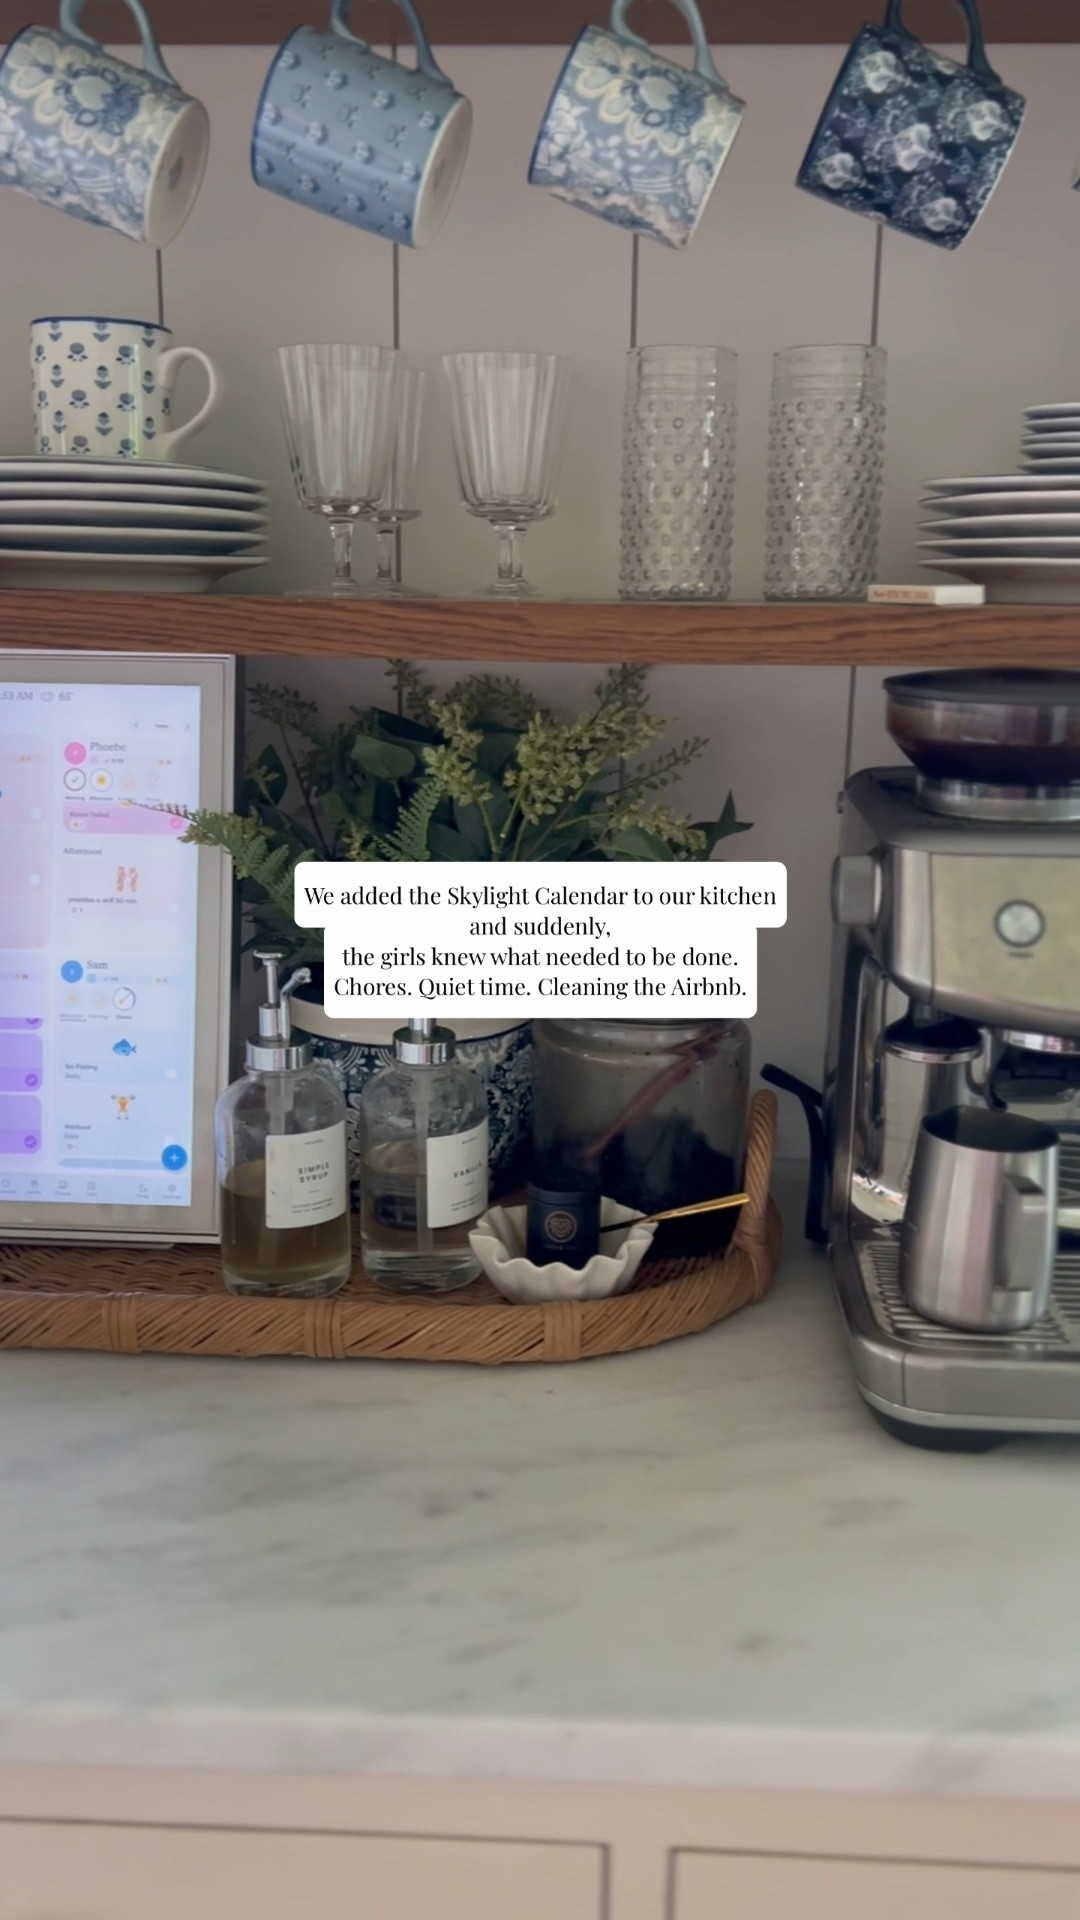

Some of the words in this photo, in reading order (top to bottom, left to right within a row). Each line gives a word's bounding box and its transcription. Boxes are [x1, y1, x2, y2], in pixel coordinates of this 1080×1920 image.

[16, 691, 34, 700] AM
[89, 742, 127, 752] Phoebe
[86, 960, 109, 969] Sam
[298, 1162, 330, 1175] SIMPLE
[299, 1171, 330, 1184] SYRUP
